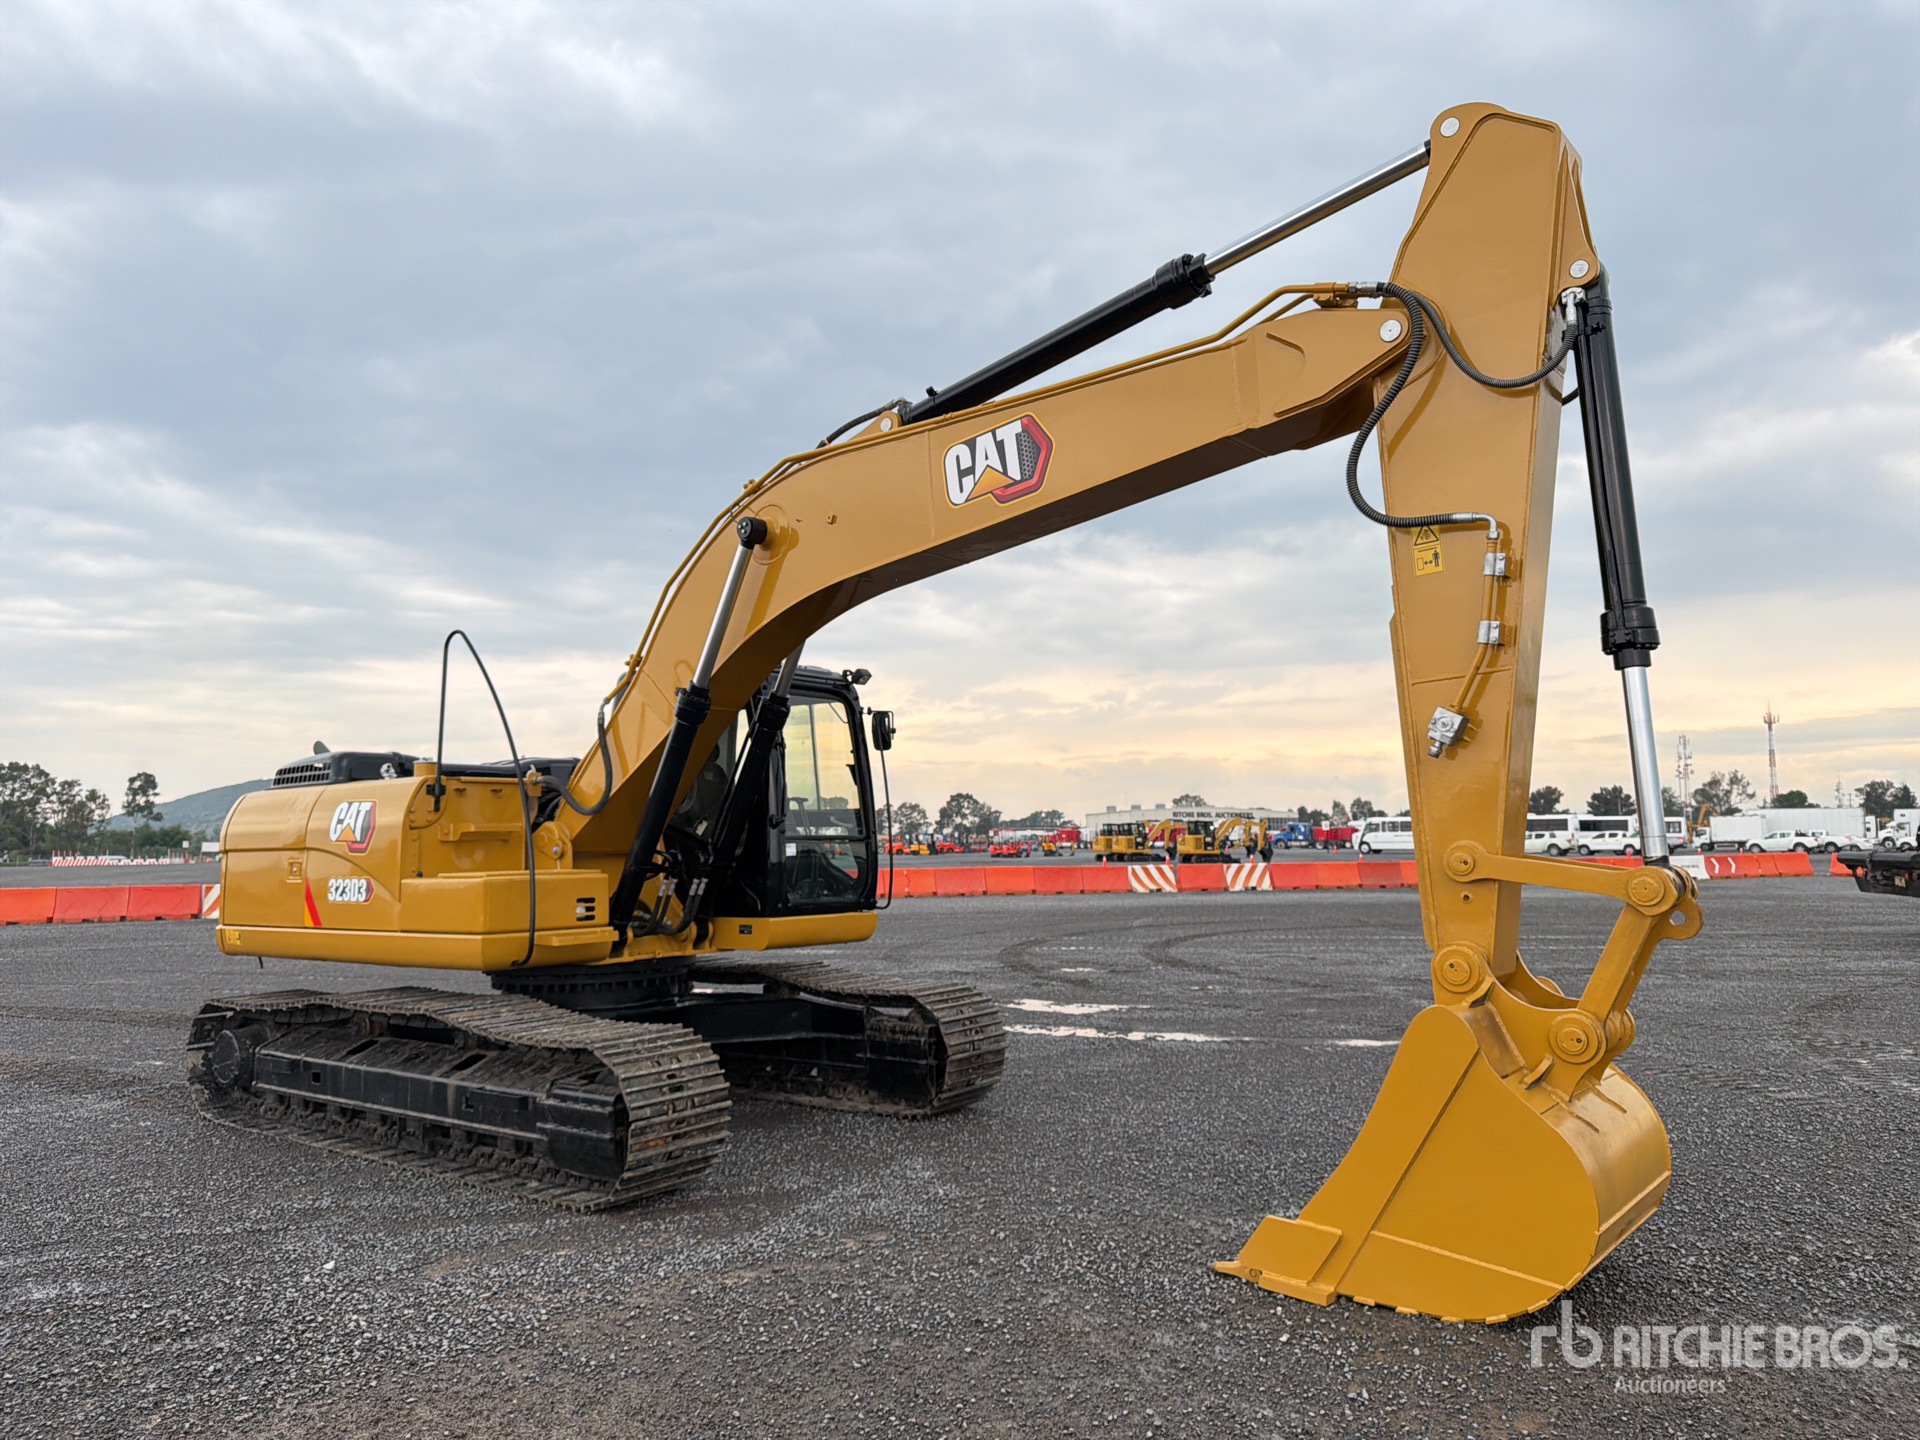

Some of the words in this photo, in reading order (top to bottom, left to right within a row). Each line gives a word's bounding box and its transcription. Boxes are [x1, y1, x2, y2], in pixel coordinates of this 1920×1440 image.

[944, 419, 1022, 504] CAT
[329, 801, 373, 842] CAT
[328, 878, 367, 903] 323D3
